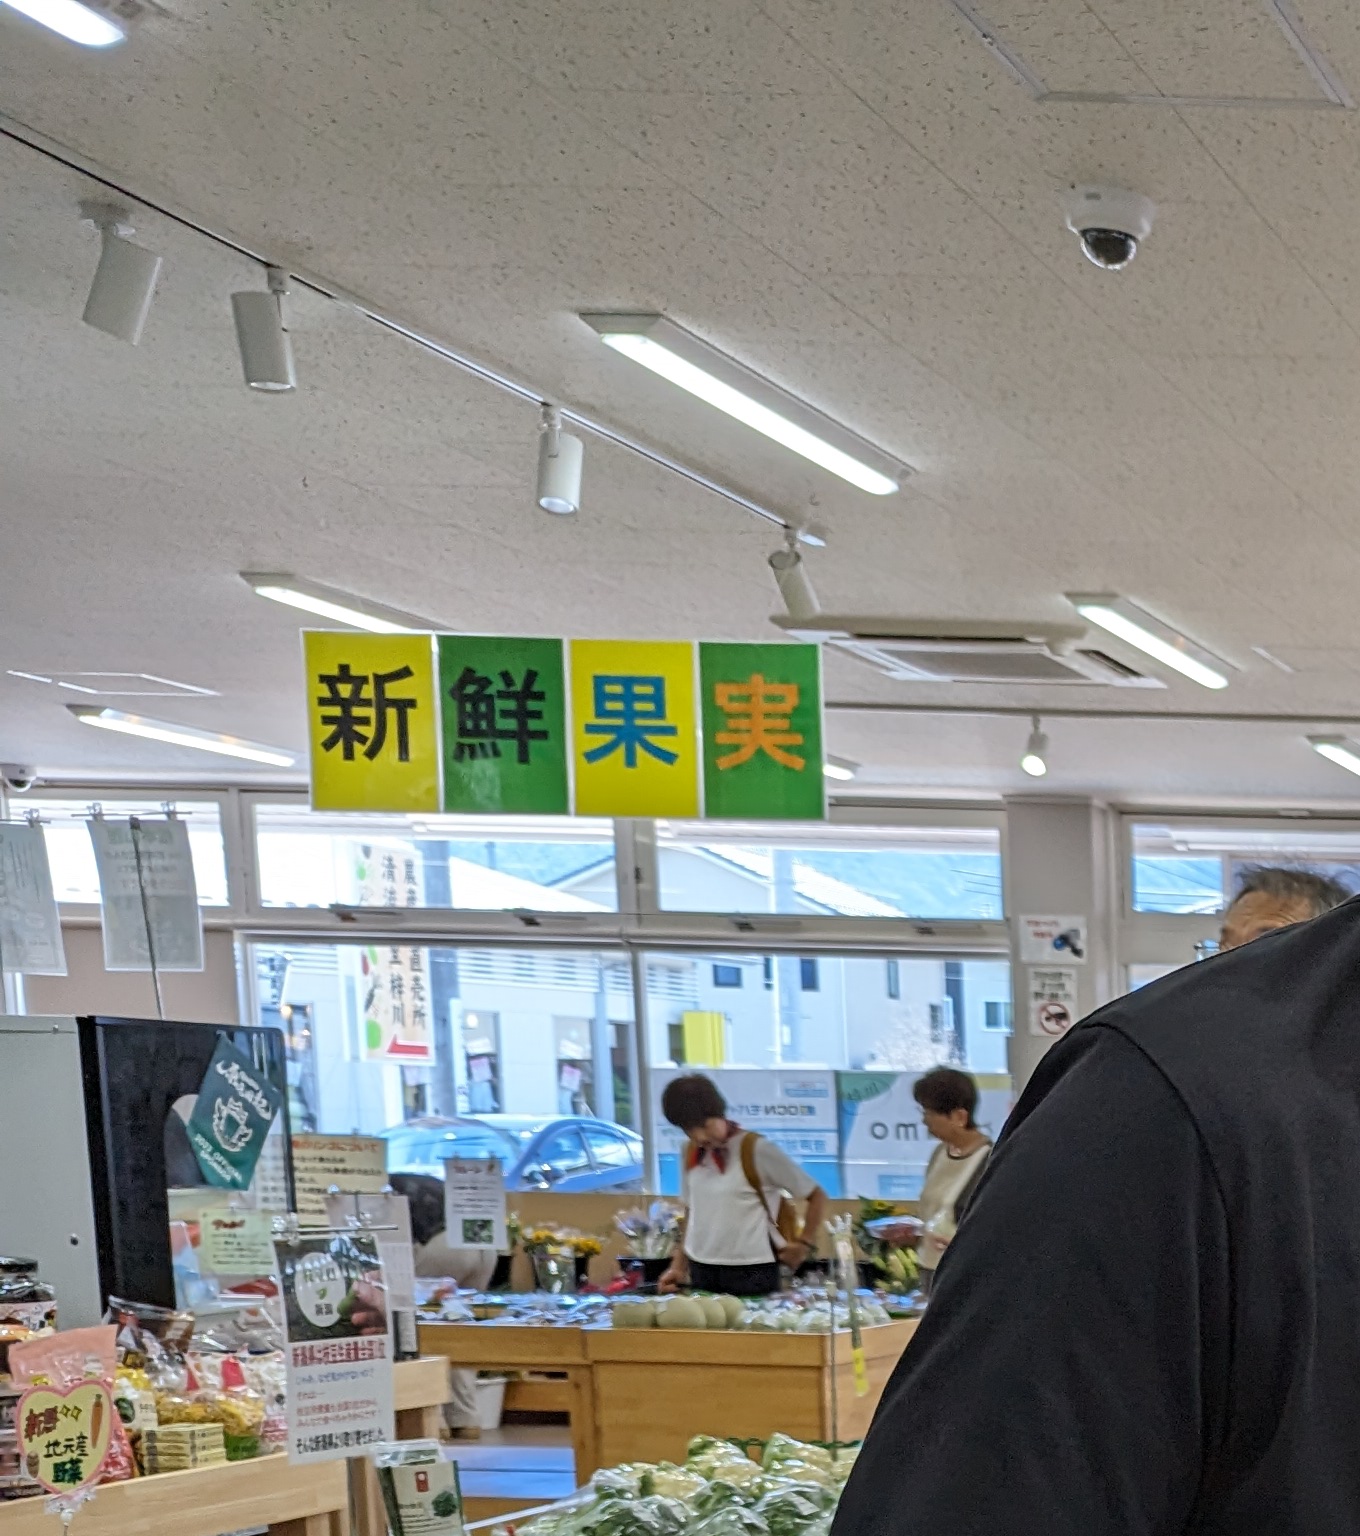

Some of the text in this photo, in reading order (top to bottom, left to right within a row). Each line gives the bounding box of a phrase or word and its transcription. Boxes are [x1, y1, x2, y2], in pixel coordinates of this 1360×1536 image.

[317, 663, 806, 771] 新鮮果実
[44, 1432, 90, 1458] 地元産
